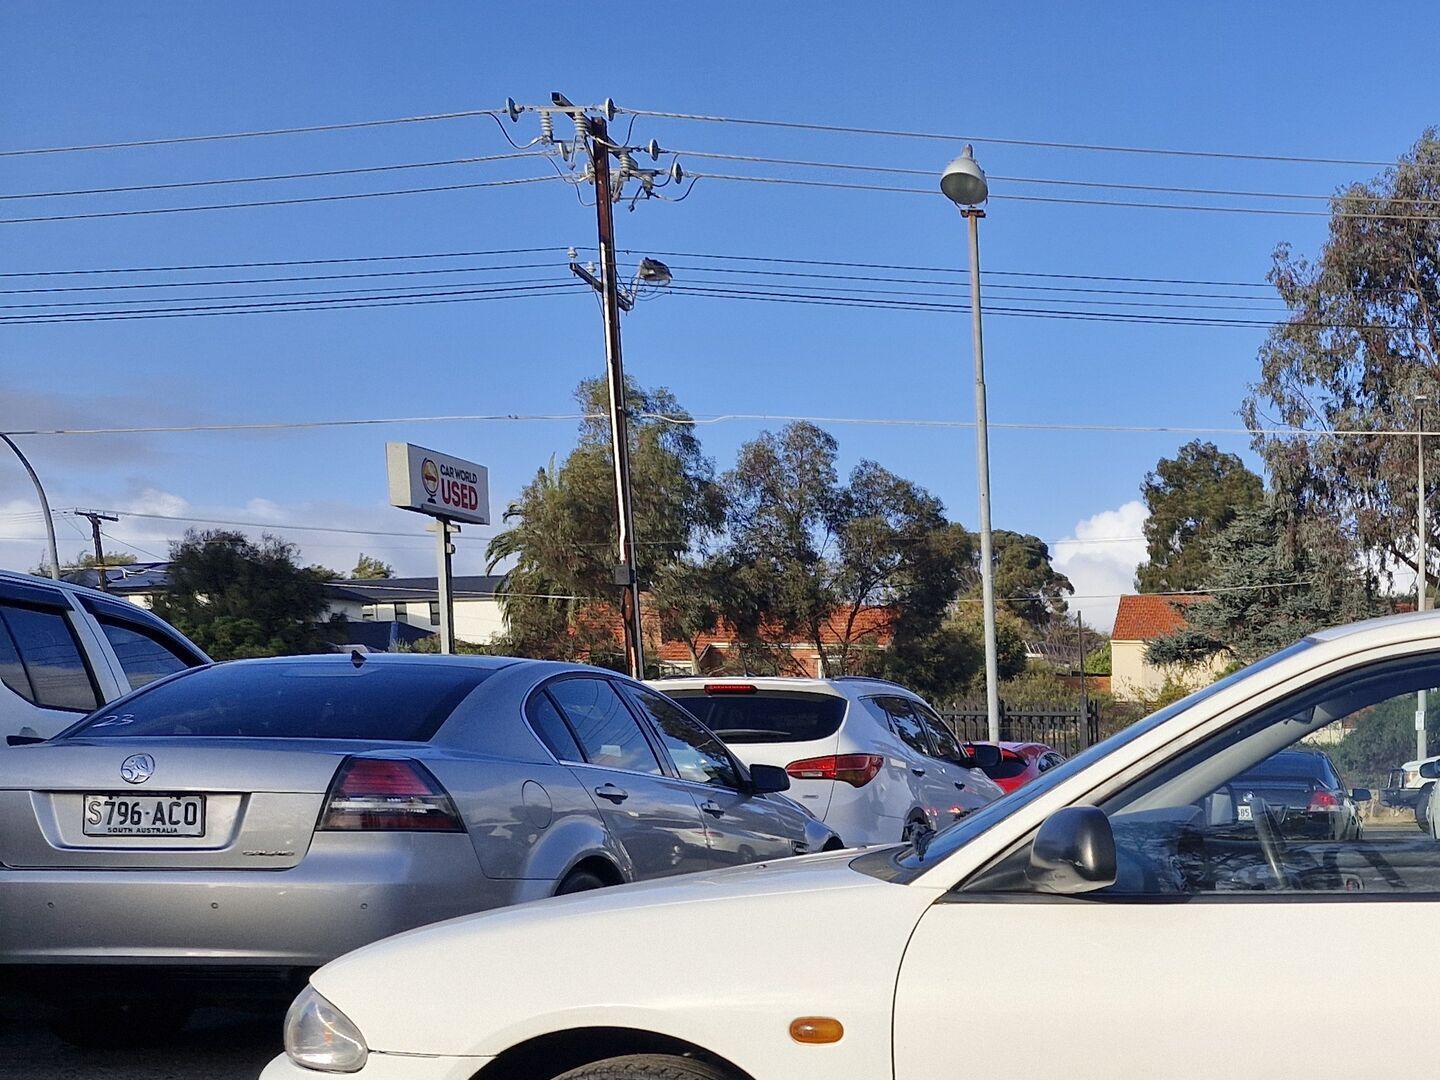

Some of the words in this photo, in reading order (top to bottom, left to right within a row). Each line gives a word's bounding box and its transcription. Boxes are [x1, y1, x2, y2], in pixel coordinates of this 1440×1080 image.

[440, 464, 455, 478] CAR
[455, 469, 478, 484] WORLD
[440, 478, 478, 511] USED
[92, 713, 135, 728] 23
